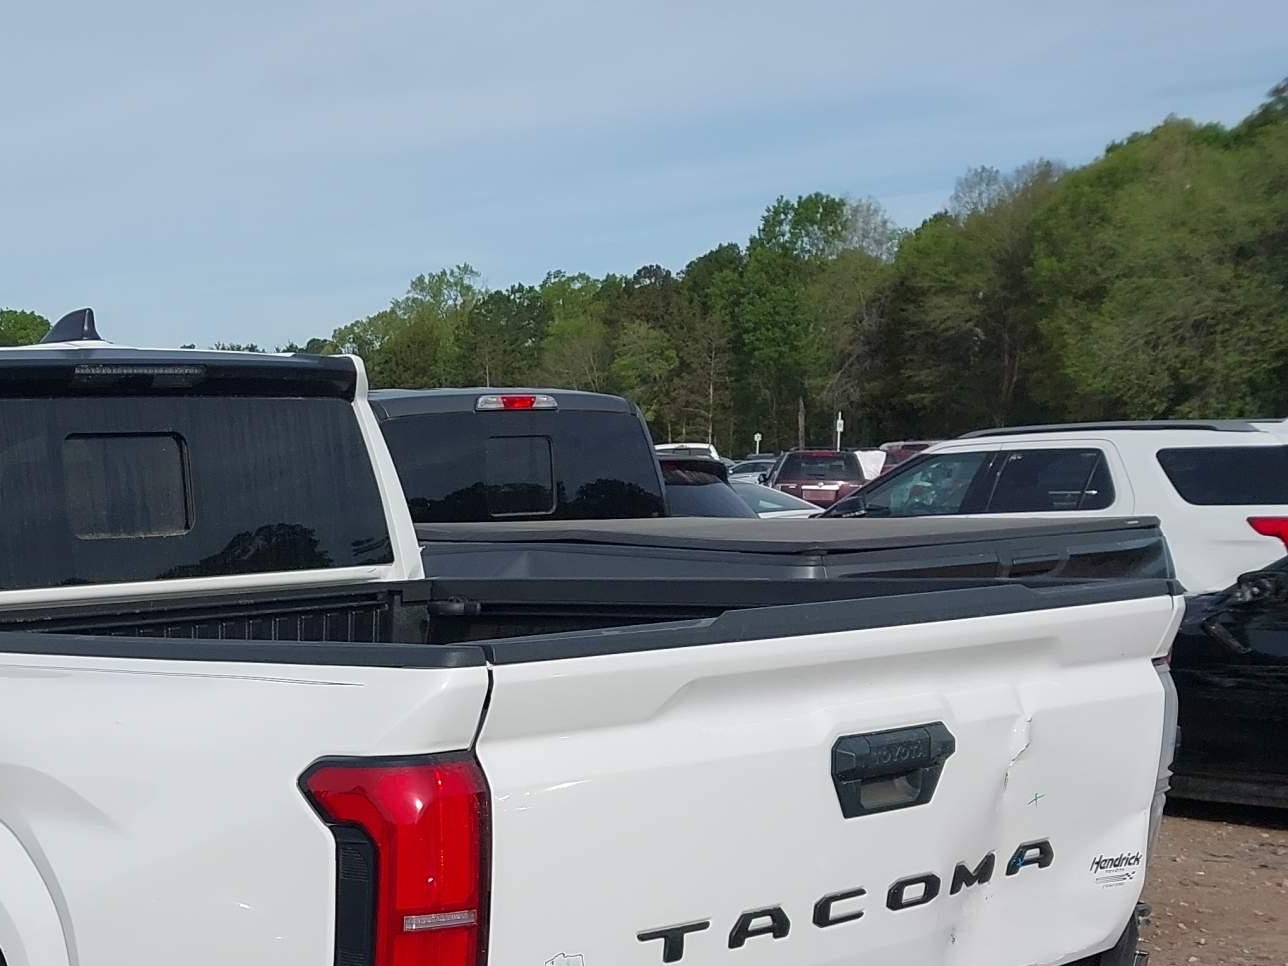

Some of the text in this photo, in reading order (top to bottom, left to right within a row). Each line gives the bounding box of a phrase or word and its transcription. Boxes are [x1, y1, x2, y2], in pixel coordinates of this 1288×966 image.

[872, 739, 927, 765] TOYOTA
[1089, 850, 1143, 874] Hendrick
[636, 837, 1054, 963] TACOMA
